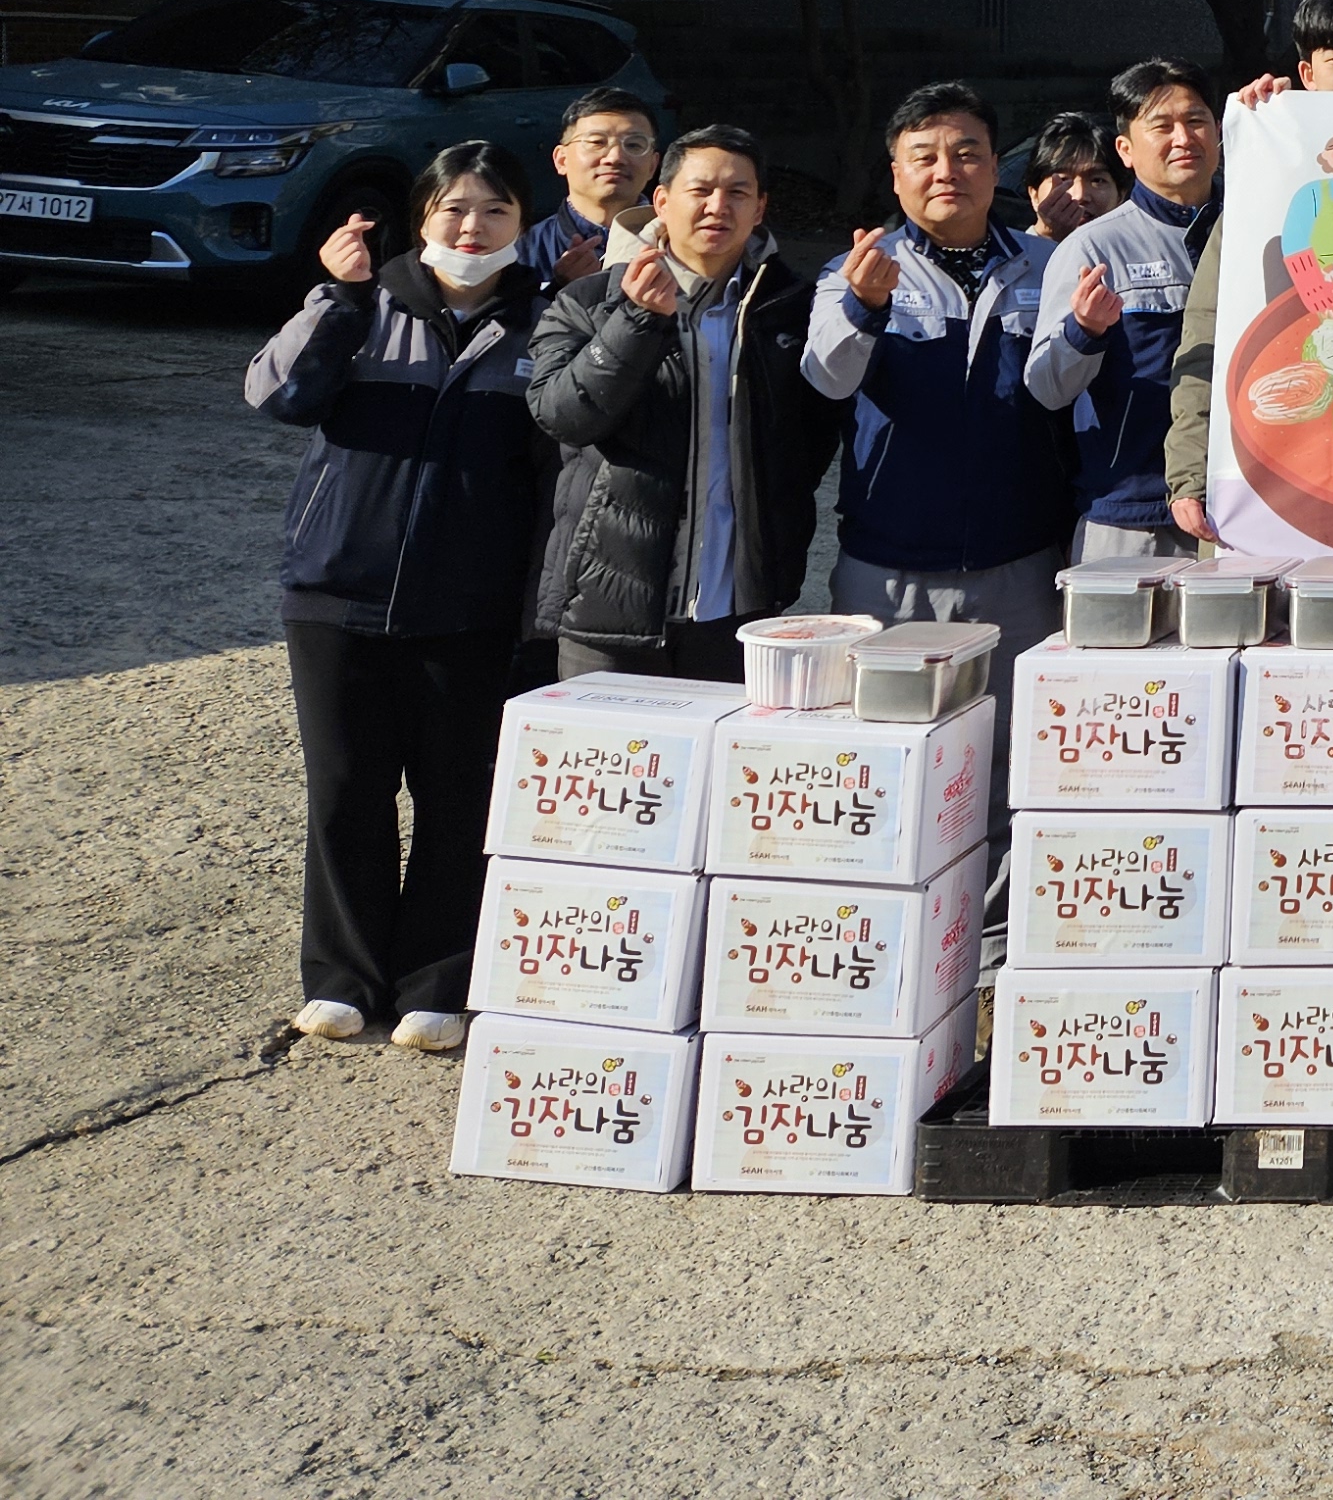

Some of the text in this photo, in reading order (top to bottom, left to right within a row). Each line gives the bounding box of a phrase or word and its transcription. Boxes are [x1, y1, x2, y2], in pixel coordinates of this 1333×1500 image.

[39, 197, 87, 218] 1012
[1077, 691, 1152, 720] 사랑의
[1049, 720, 1187, 765] 김장나눔
[558, 748, 634, 776] 사랑의
[769, 762, 844, 790] 사랑의
[530, 774, 662, 825] 김장나눔
[742, 790, 876, 836] 김장나눔
[1075, 846, 1150, 876] 사랑의
[1047, 875, 1185, 920] 김장나눔
[539, 906, 613, 934] 사랑의
[768, 915, 844, 943] 사랑의
[512, 934, 643, 982] 김장나눔
[740, 943, 876, 990] 김장나눔
[1058, 1011, 1133, 1041] 사랑의
[1031, 1040, 1168, 1085] 김장나눔
[531, 1068, 609, 1096] 사랑의
[763, 1074, 840, 1102] 사랑의
[503, 1096, 641, 1144] 김장나눔
[735, 1103, 872, 1148] 김장나눔
